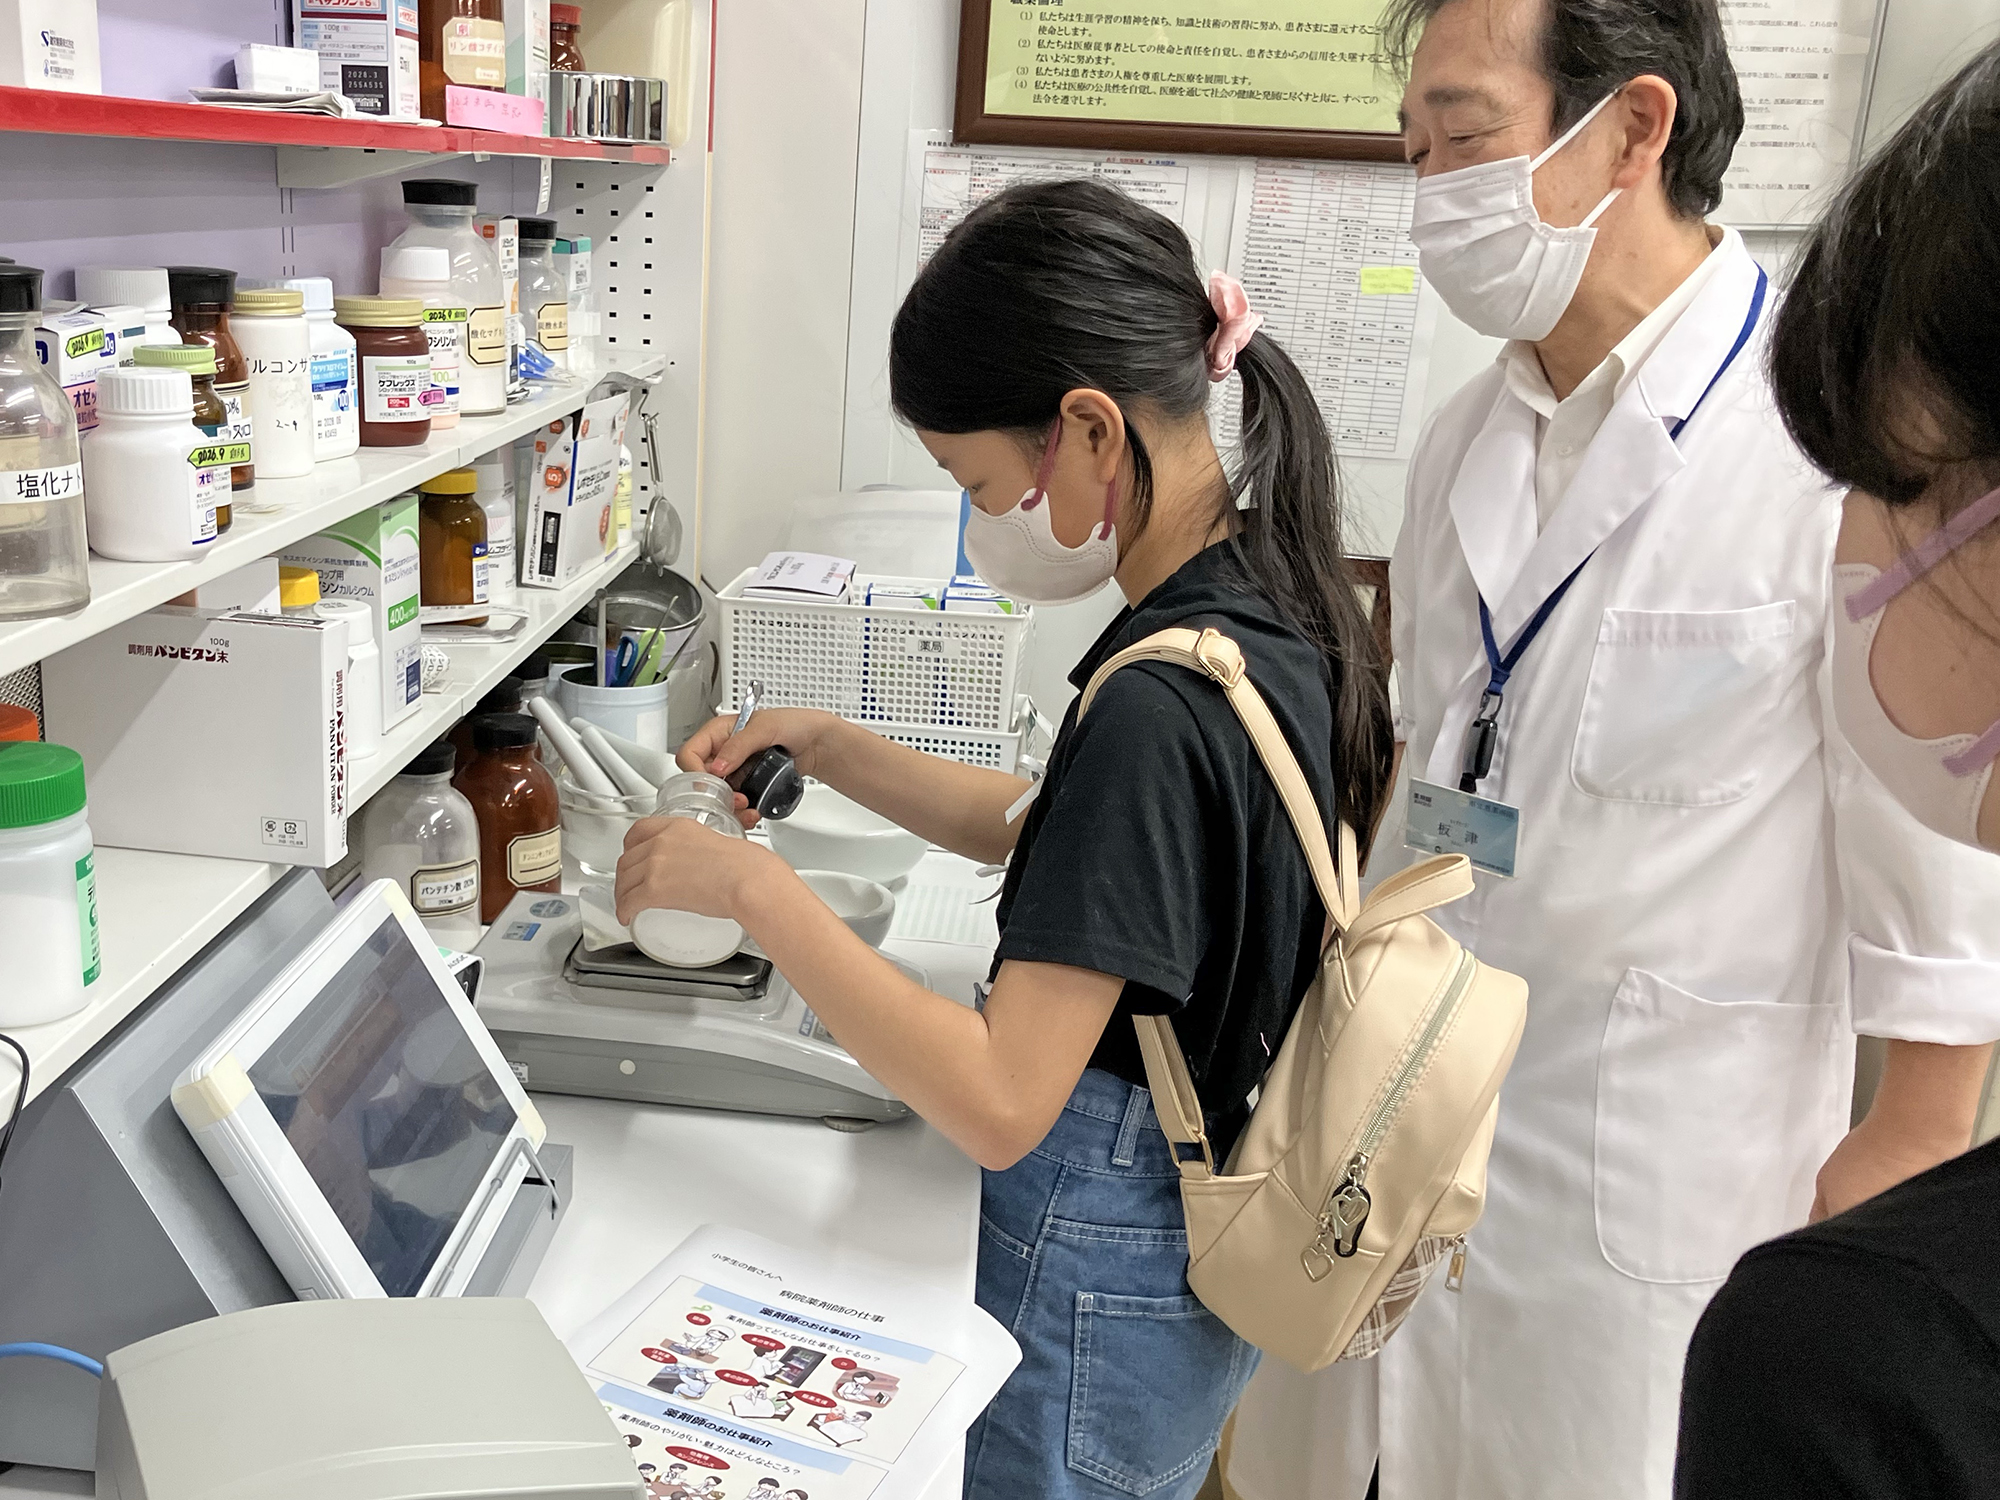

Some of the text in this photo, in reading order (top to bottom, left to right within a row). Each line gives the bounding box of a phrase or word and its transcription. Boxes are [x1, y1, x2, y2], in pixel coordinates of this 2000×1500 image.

[1019, 11, 1033, 21] (1)
[1038, 26, 1093, 37] 使命とします。
[1017, 39, 1031, 49] (2)
[1035, 53, 1116, 66] ないように努めます。
[348, 71, 378, 79] 2028.3
[1016, 66, 1029, 76] (3)
[1014, 79, 1028, 90] (4)
[1032, 93, 1107, 107] 法令を遵守します。
[246, 357, 307, 374] ルコンサ
[378, 379, 416, 388] ケフレックス
[16, 468, 81, 498] 塩化ナト
[317, 569, 345, 581] ロップ用
[209, 637, 230, 648] 100g
[920, 640, 942, 653] 薬局
[329, 719, 337, 781] PANVITAN
[712, 1252, 783, 1282] 小学生の皆さんへ
[779, 1290, 885, 1324] 病院薬剤師の仕事
[758, 1306, 862, 1342] 薬剤師のお仕事紹介
[726, 1314, 880, 1363] 薬剤師ってどんなお仕事をしてるの？
[662, 1407, 773, 1448] 薬剤師のお仕事紹介
[618, 1413, 800, 1475] 薬剤師のやりがい・魅力はどんなところ？
